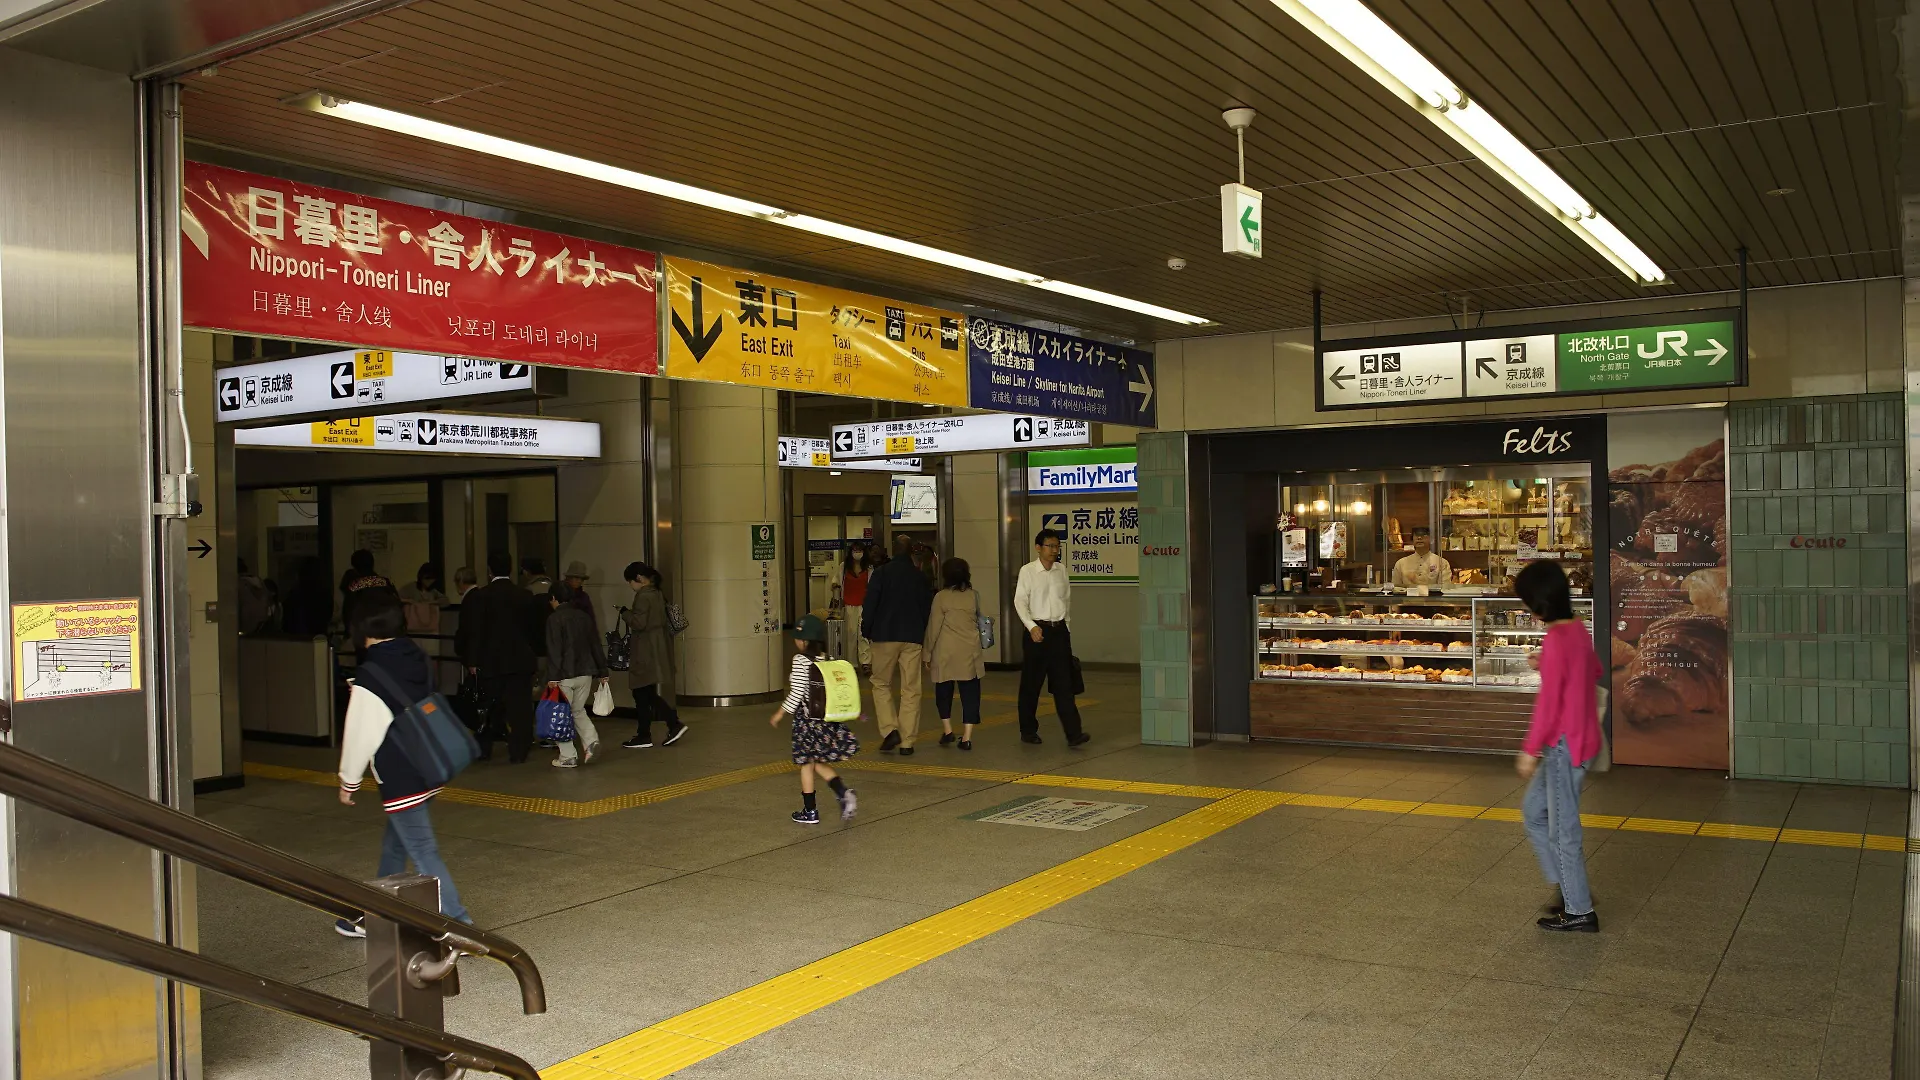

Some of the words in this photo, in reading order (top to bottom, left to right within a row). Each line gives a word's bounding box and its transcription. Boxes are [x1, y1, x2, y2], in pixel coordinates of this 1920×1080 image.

[249, 187, 636, 288] 日暮里・舎人ライナー
[251, 247, 398, 291] Nippori-Toneri
[407, 271, 450, 298] Liner
[735, 279, 798, 331] 東口
[886, 308, 905, 319] TAXI
[448, 316, 495, 341] 닛포리
[503, 325, 548, 347] 도네리
[556, 330, 598, 352] 라이너
[912, 322, 933, 340] バス
[741, 333, 767, 354] East
[772, 337, 794, 357] Exit
[833, 334, 851, 349] Taxi
[1567, 335, 1630, 353] 北改札口
[1637, 330, 1689, 359] JR
[364, 352, 384, 364] 東口
[834, 352, 861, 369] 出租车
[991, 351, 1035, 371] 成田空港方面
[1580, 353, 1605, 363] North
[1607, 352, 1630, 361] Gate
[1644, 359, 1682, 369] JR東日本
[463, 371, 474, 381] JR
[476, 370, 493, 380] Line
[741, 361, 761, 377] 东口
[770, 365, 790, 383] 동쪽
[794, 367, 815, 384] 출구
[1505, 367, 1545, 381] 京成線
[260, 373, 293, 394] 京成線
[991, 371, 1012, 385] Keisei
[1013, 374, 1026, 388] Line
[1035, 379, 1058, 393] Skyliner
[1059, 380, 1068, 393] for
[1068, 383, 1086, 396] Narita
[1086, 385, 1105, 399] Airport
[1360, 374, 1453, 390] 日暮里・舎人ライナー
[1505, 381, 1529, 390] Keisei
[1530, 380, 1547, 389] Line
[260, 395, 279, 405] Keisei
[280, 394, 294, 403] Line
[1409, 388, 1427, 396] Liner
[439, 424, 538, 440] 東京都荒川都税事務所
[1053, 419, 1086, 430] 京成線
[439, 437, 464, 445] Arakawa
[465, 438, 500, 447] Metropolitan
[1053, 430, 1072, 438] Keisei
[1503, 426, 1573, 455] Felts
[1040, 466, 1138, 487] FamilyMart
[1072, 507, 1139, 530] 京成線
[1072, 533, 1110, 545] Keisei
[1114, 533, 1139, 545] Line
[1618, 526, 1661, 548] NOTRE
[1072, 550, 1099, 560] 京成线
[1072, 564, 1114, 573] 게이세이선
[56, 614, 137, 628] 動いているシャッターの
